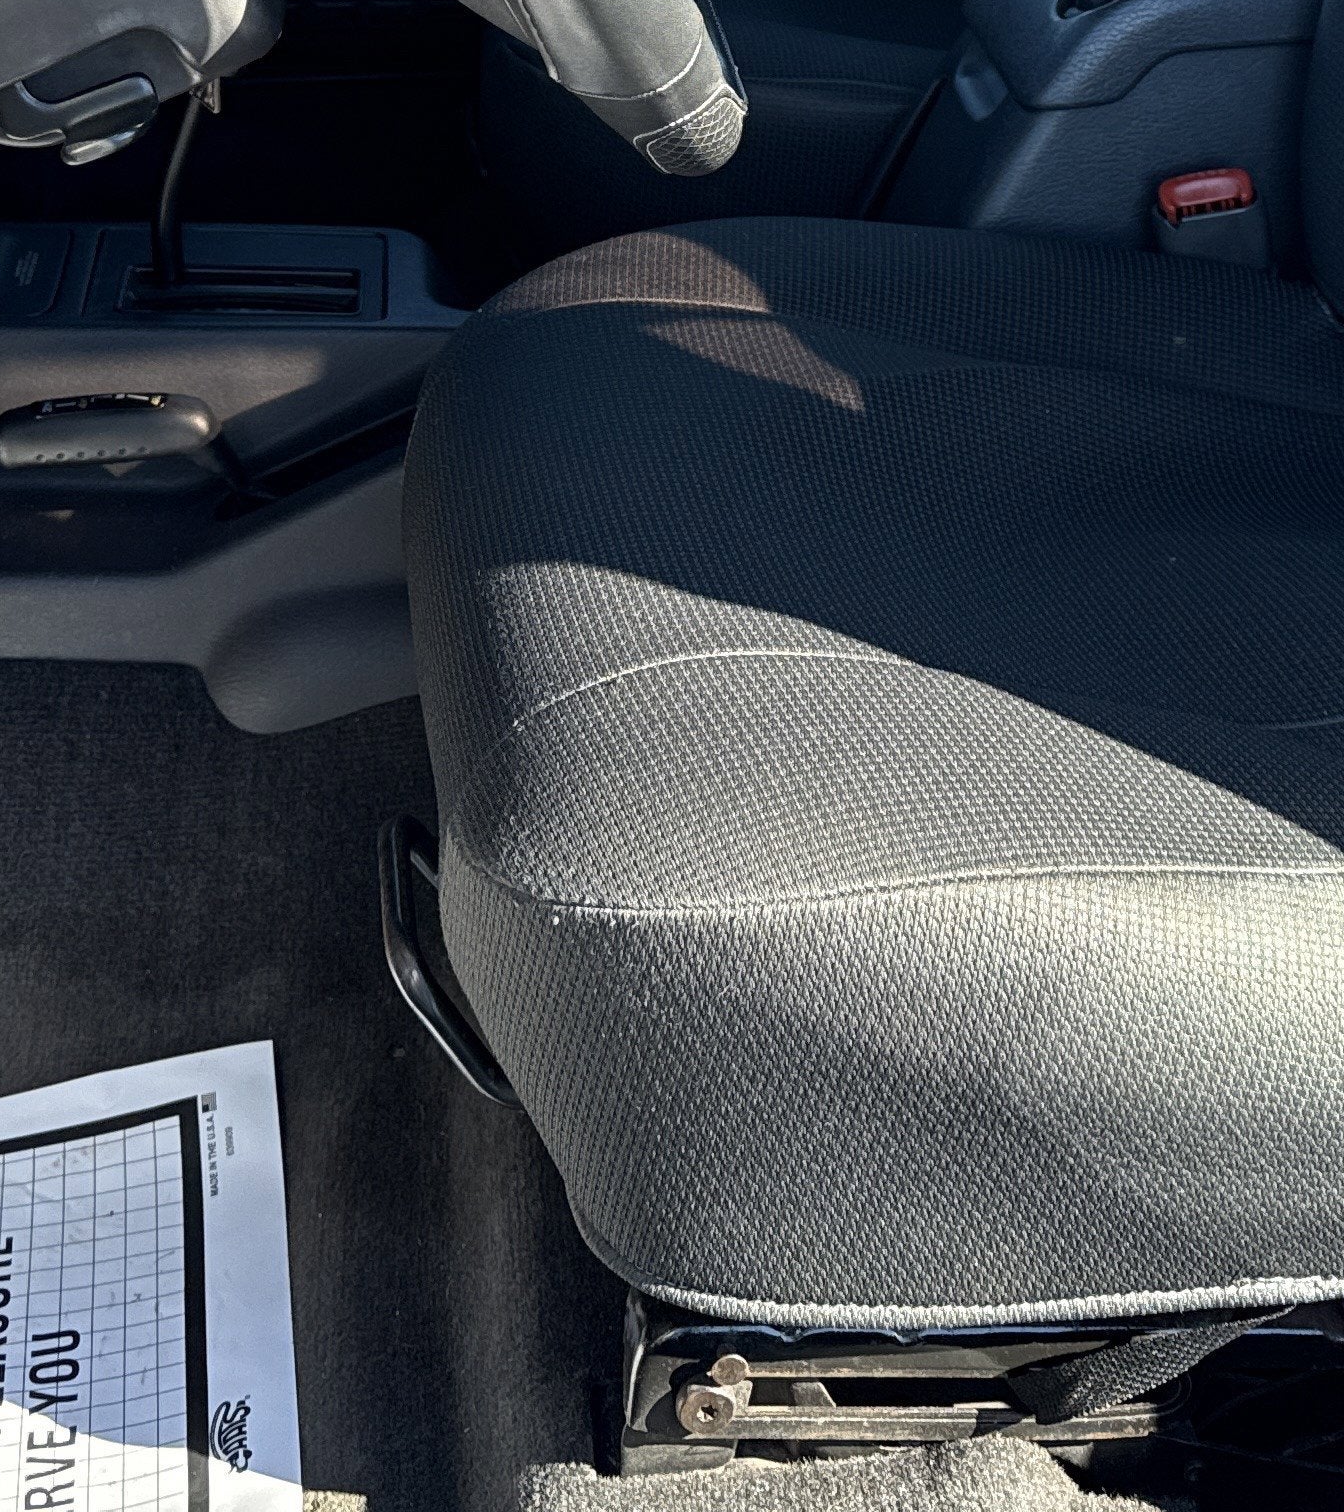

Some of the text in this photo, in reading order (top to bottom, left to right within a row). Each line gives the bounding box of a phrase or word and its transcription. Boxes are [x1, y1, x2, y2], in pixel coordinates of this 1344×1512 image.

[208, 1142, 217, 1161] THE
[209, 1172, 218, 1197] MADE
[28, 1330, 80, 1416] YOU
